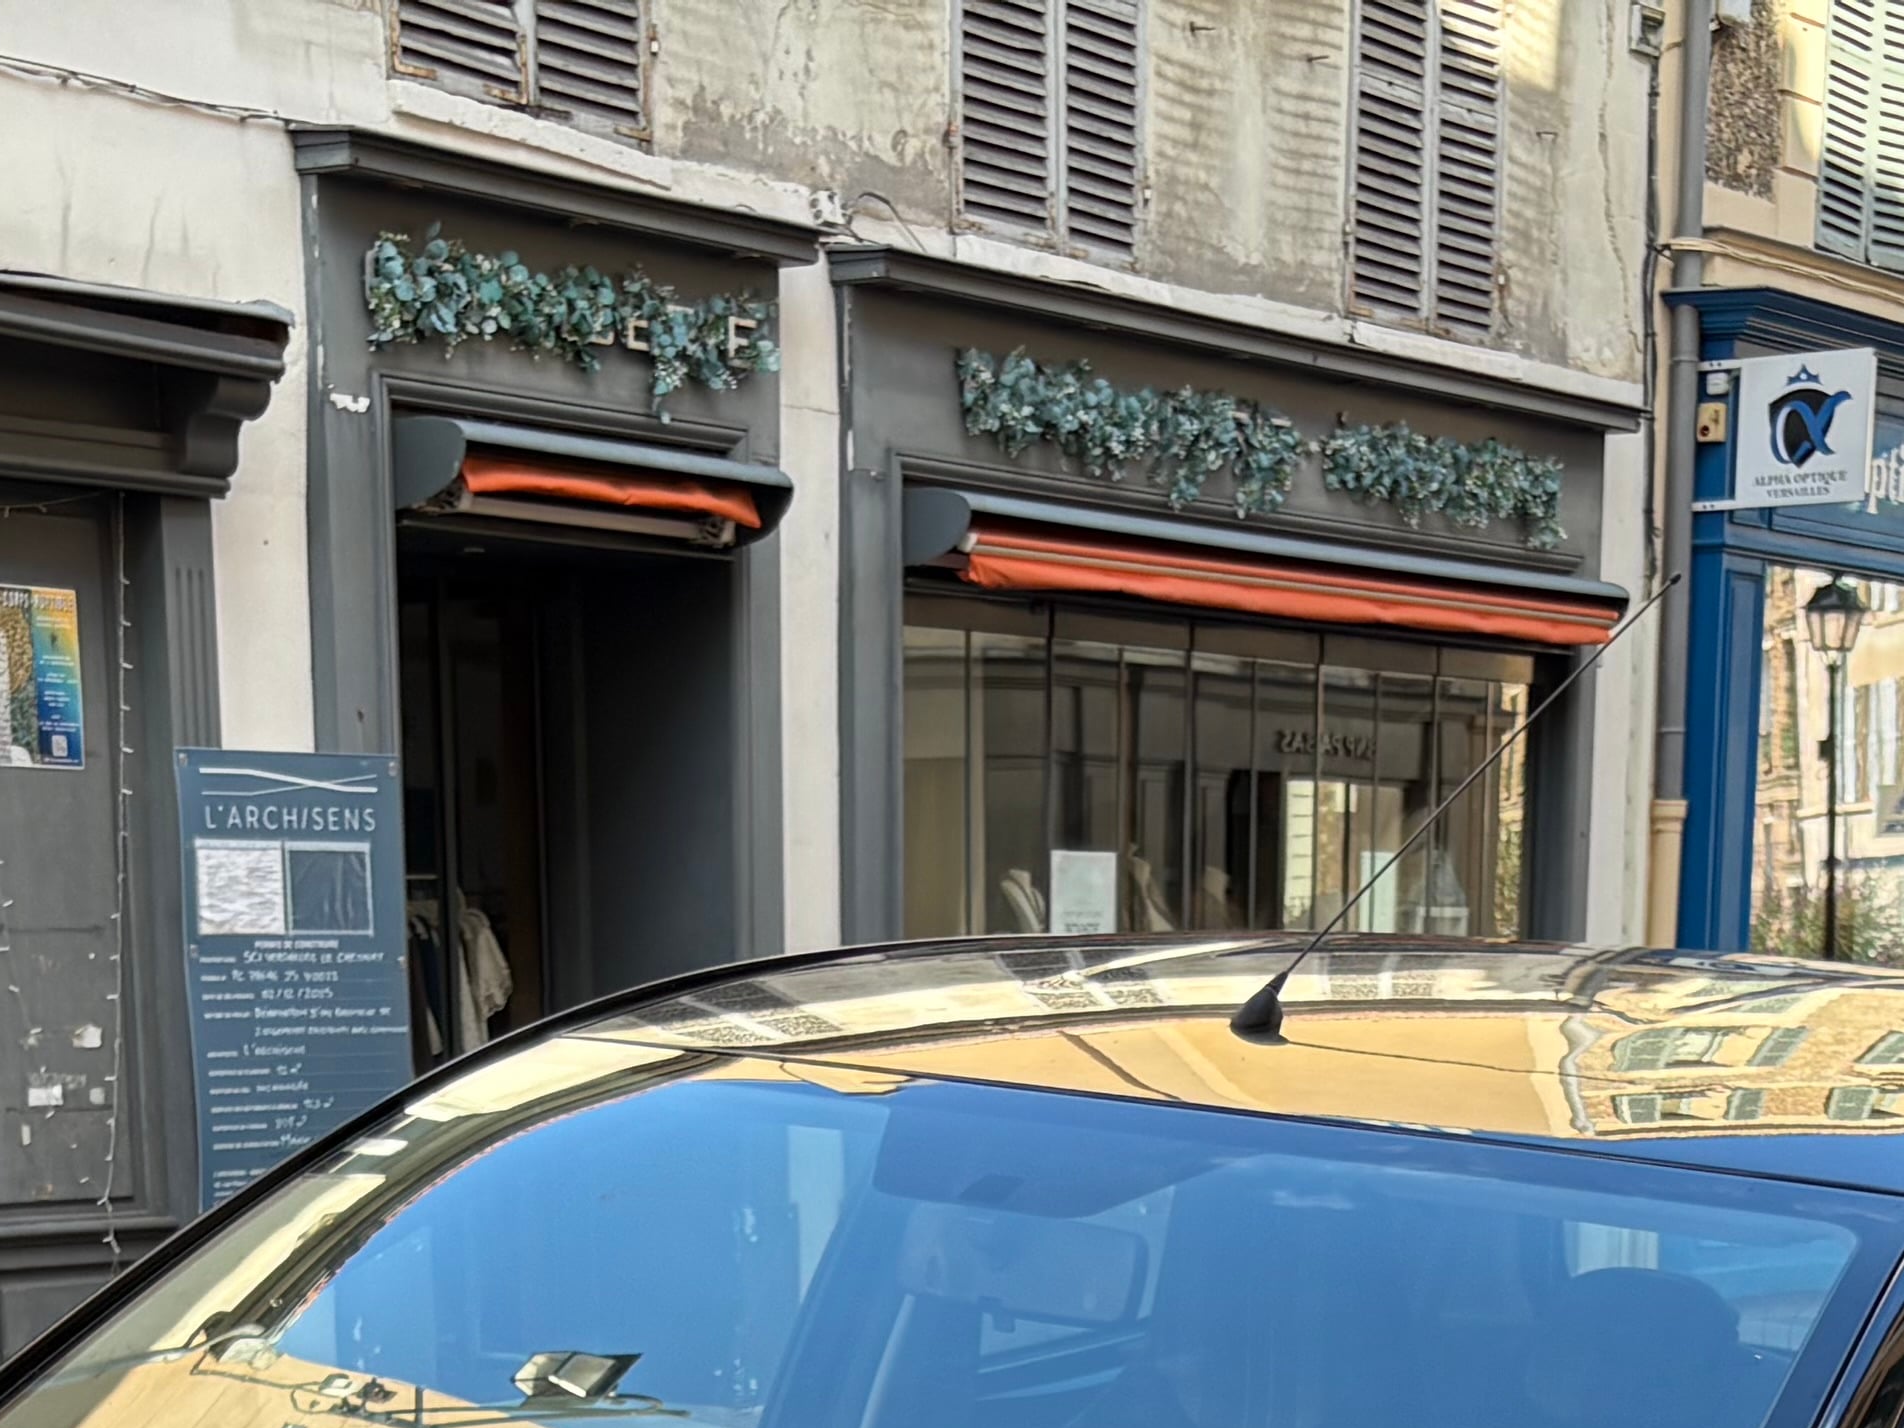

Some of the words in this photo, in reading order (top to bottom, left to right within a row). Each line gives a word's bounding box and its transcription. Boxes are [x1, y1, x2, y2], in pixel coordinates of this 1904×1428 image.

[1752, 470, 1792, 488] ALPHA
[1793, 470, 1848, 487] OPTIQUE
[1766, 486, 1831, 500] VERSAILLES
[204, 804, 377, 833] L'ARCHISENS
